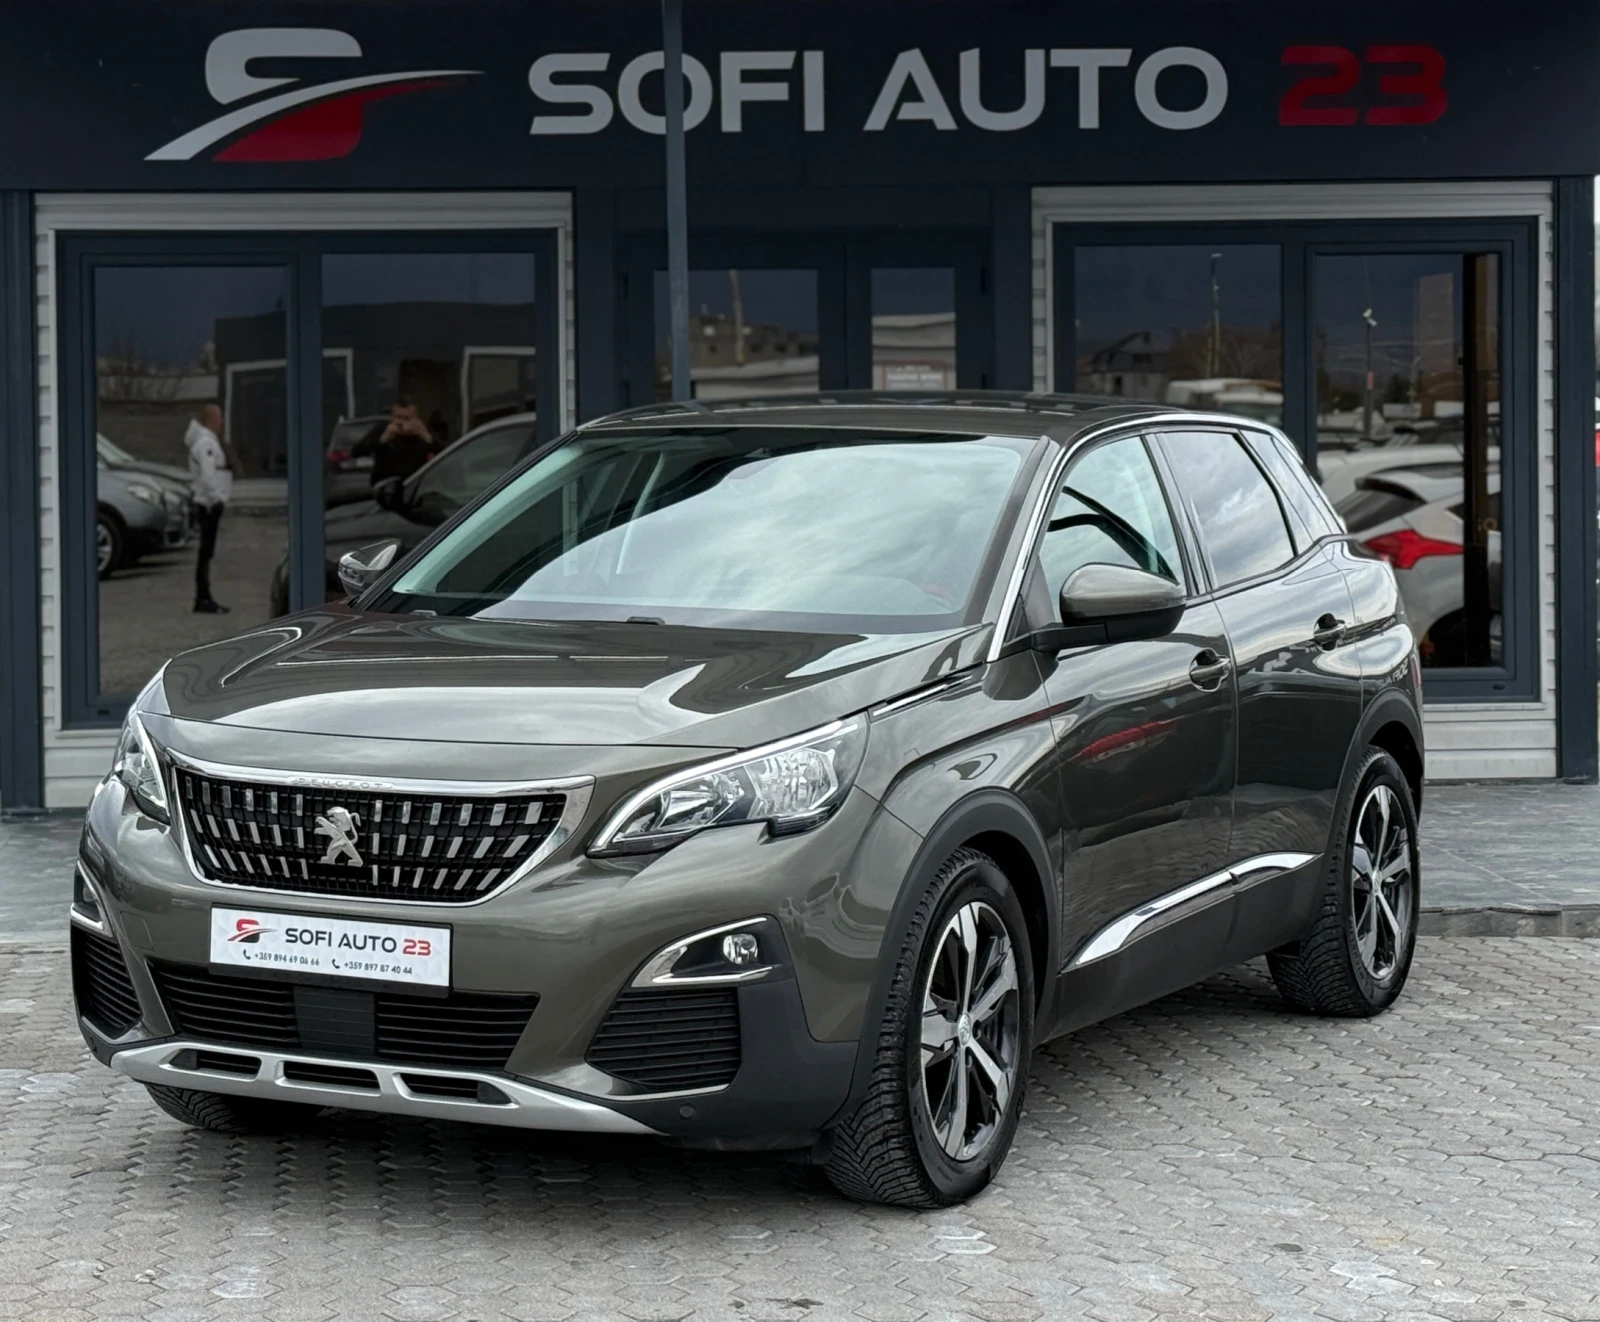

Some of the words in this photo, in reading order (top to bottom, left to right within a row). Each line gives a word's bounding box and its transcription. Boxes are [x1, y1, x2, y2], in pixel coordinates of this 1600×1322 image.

[528, 50, 824, 135] SOFI
[864, 46, 1228, 132] AUTO
[1278, 44, 1448, 127] 23
[285, 927, 332, 947] SOFI
[338, 933, 397, 953] AUTO
[402, 938, 432, 957] 23
[254, 951, 272, 961] +359
[273, 953, 287, 963] 894
[288, 955, 298, 964] 69
[310, 958, 320, 966] 66
[344, 961, 363, 970] +359
[364, 962, 378, 971] 897
[380, 964, 390, 973] 87
[391, 965, 401, 974] 40
[402, 966, 413, 975] 44
